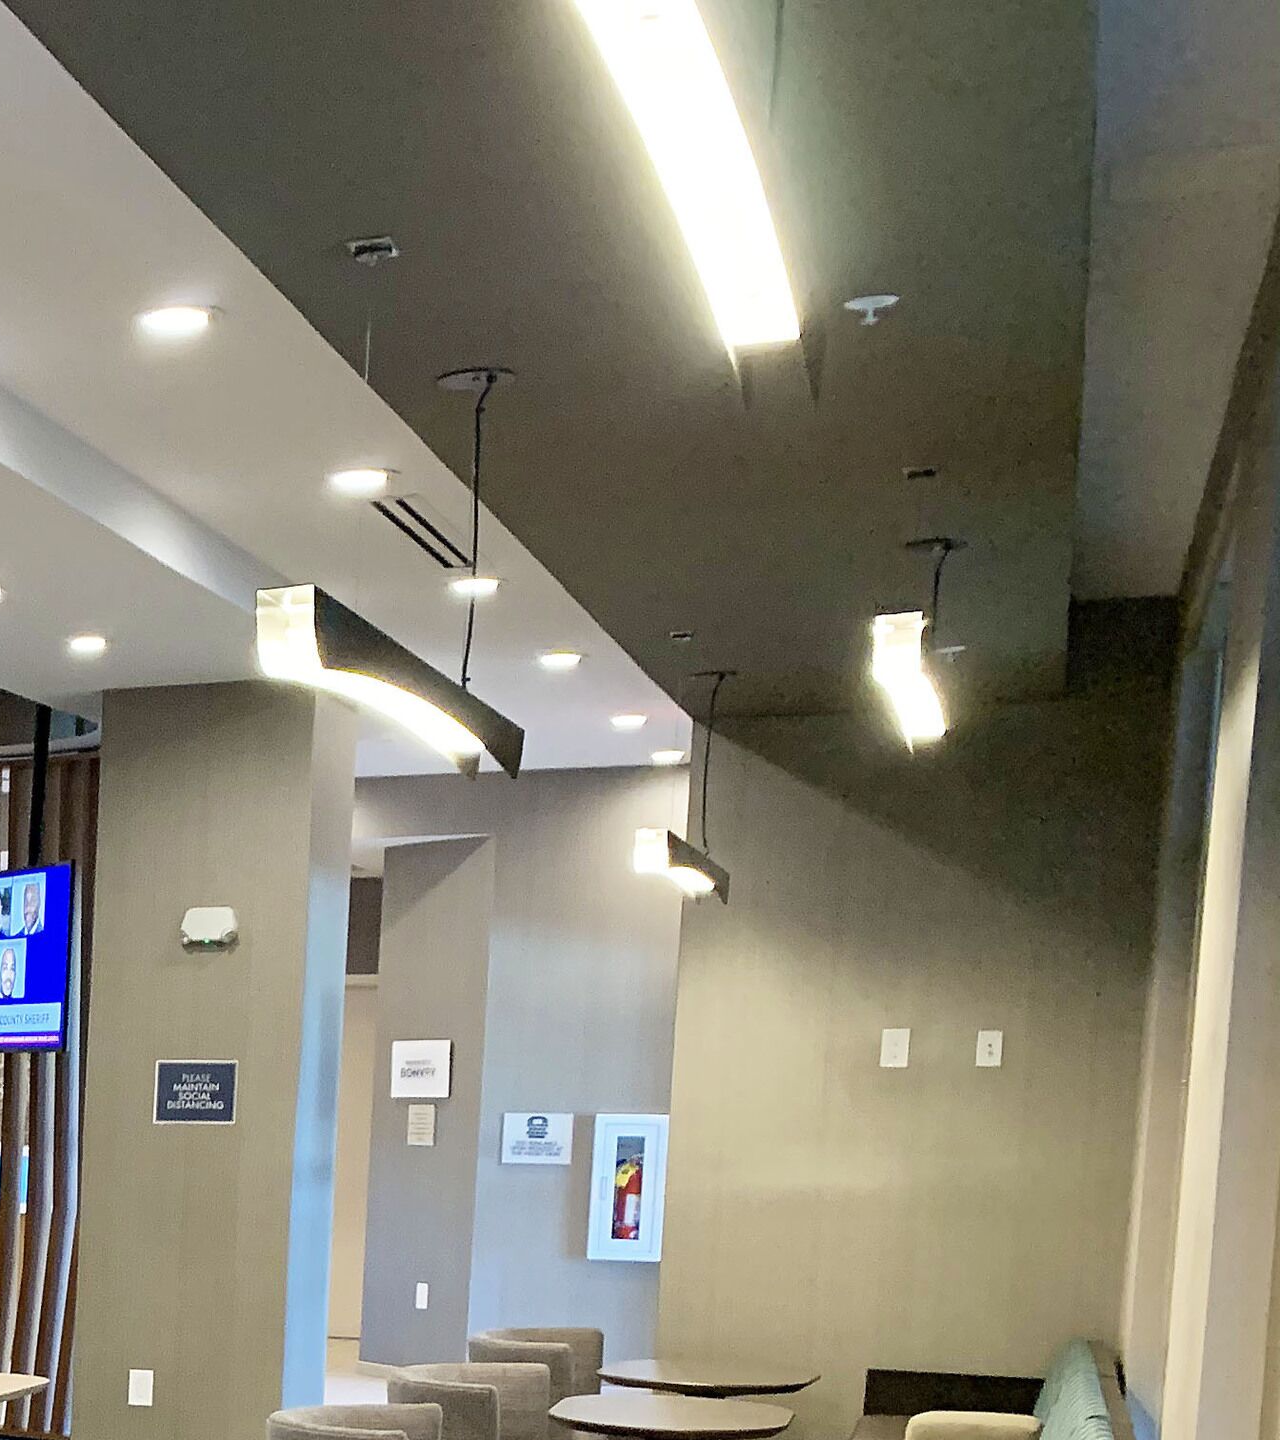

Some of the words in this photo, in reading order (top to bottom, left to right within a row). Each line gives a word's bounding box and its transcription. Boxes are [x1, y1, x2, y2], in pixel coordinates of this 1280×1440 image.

[0, 1015, 23, 1026] COUNTY
[24, 1013, 50, 1025] SHERIFF
[182, 1073, 212, 1082] PLEASE
[173, 1082, 220, 1091] MAINTAIN
[178, 1092, 211, 1101] SOCIAL
[167, 1100, 224, 1110] DISTANCING
